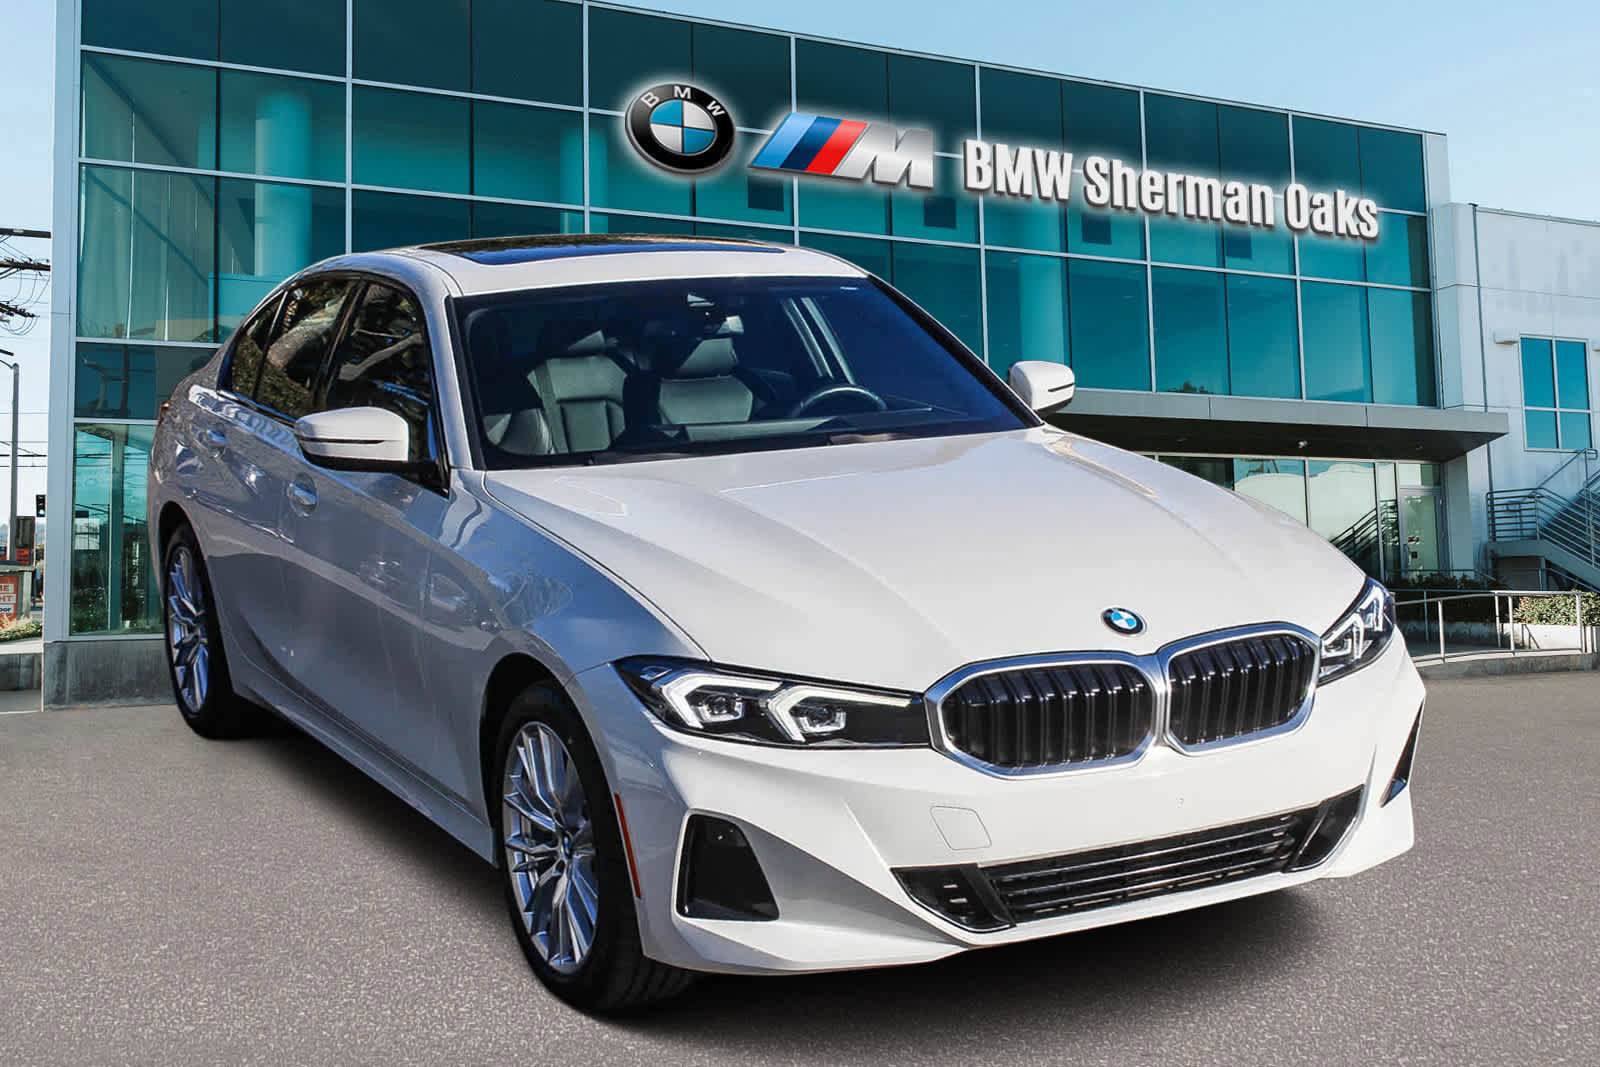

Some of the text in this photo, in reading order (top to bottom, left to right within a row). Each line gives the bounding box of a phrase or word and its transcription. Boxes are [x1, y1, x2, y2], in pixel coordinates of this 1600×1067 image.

[641, 84, 725, 117] BMW
[963, 138, 1379, 240] BMW Sherman Oaks
